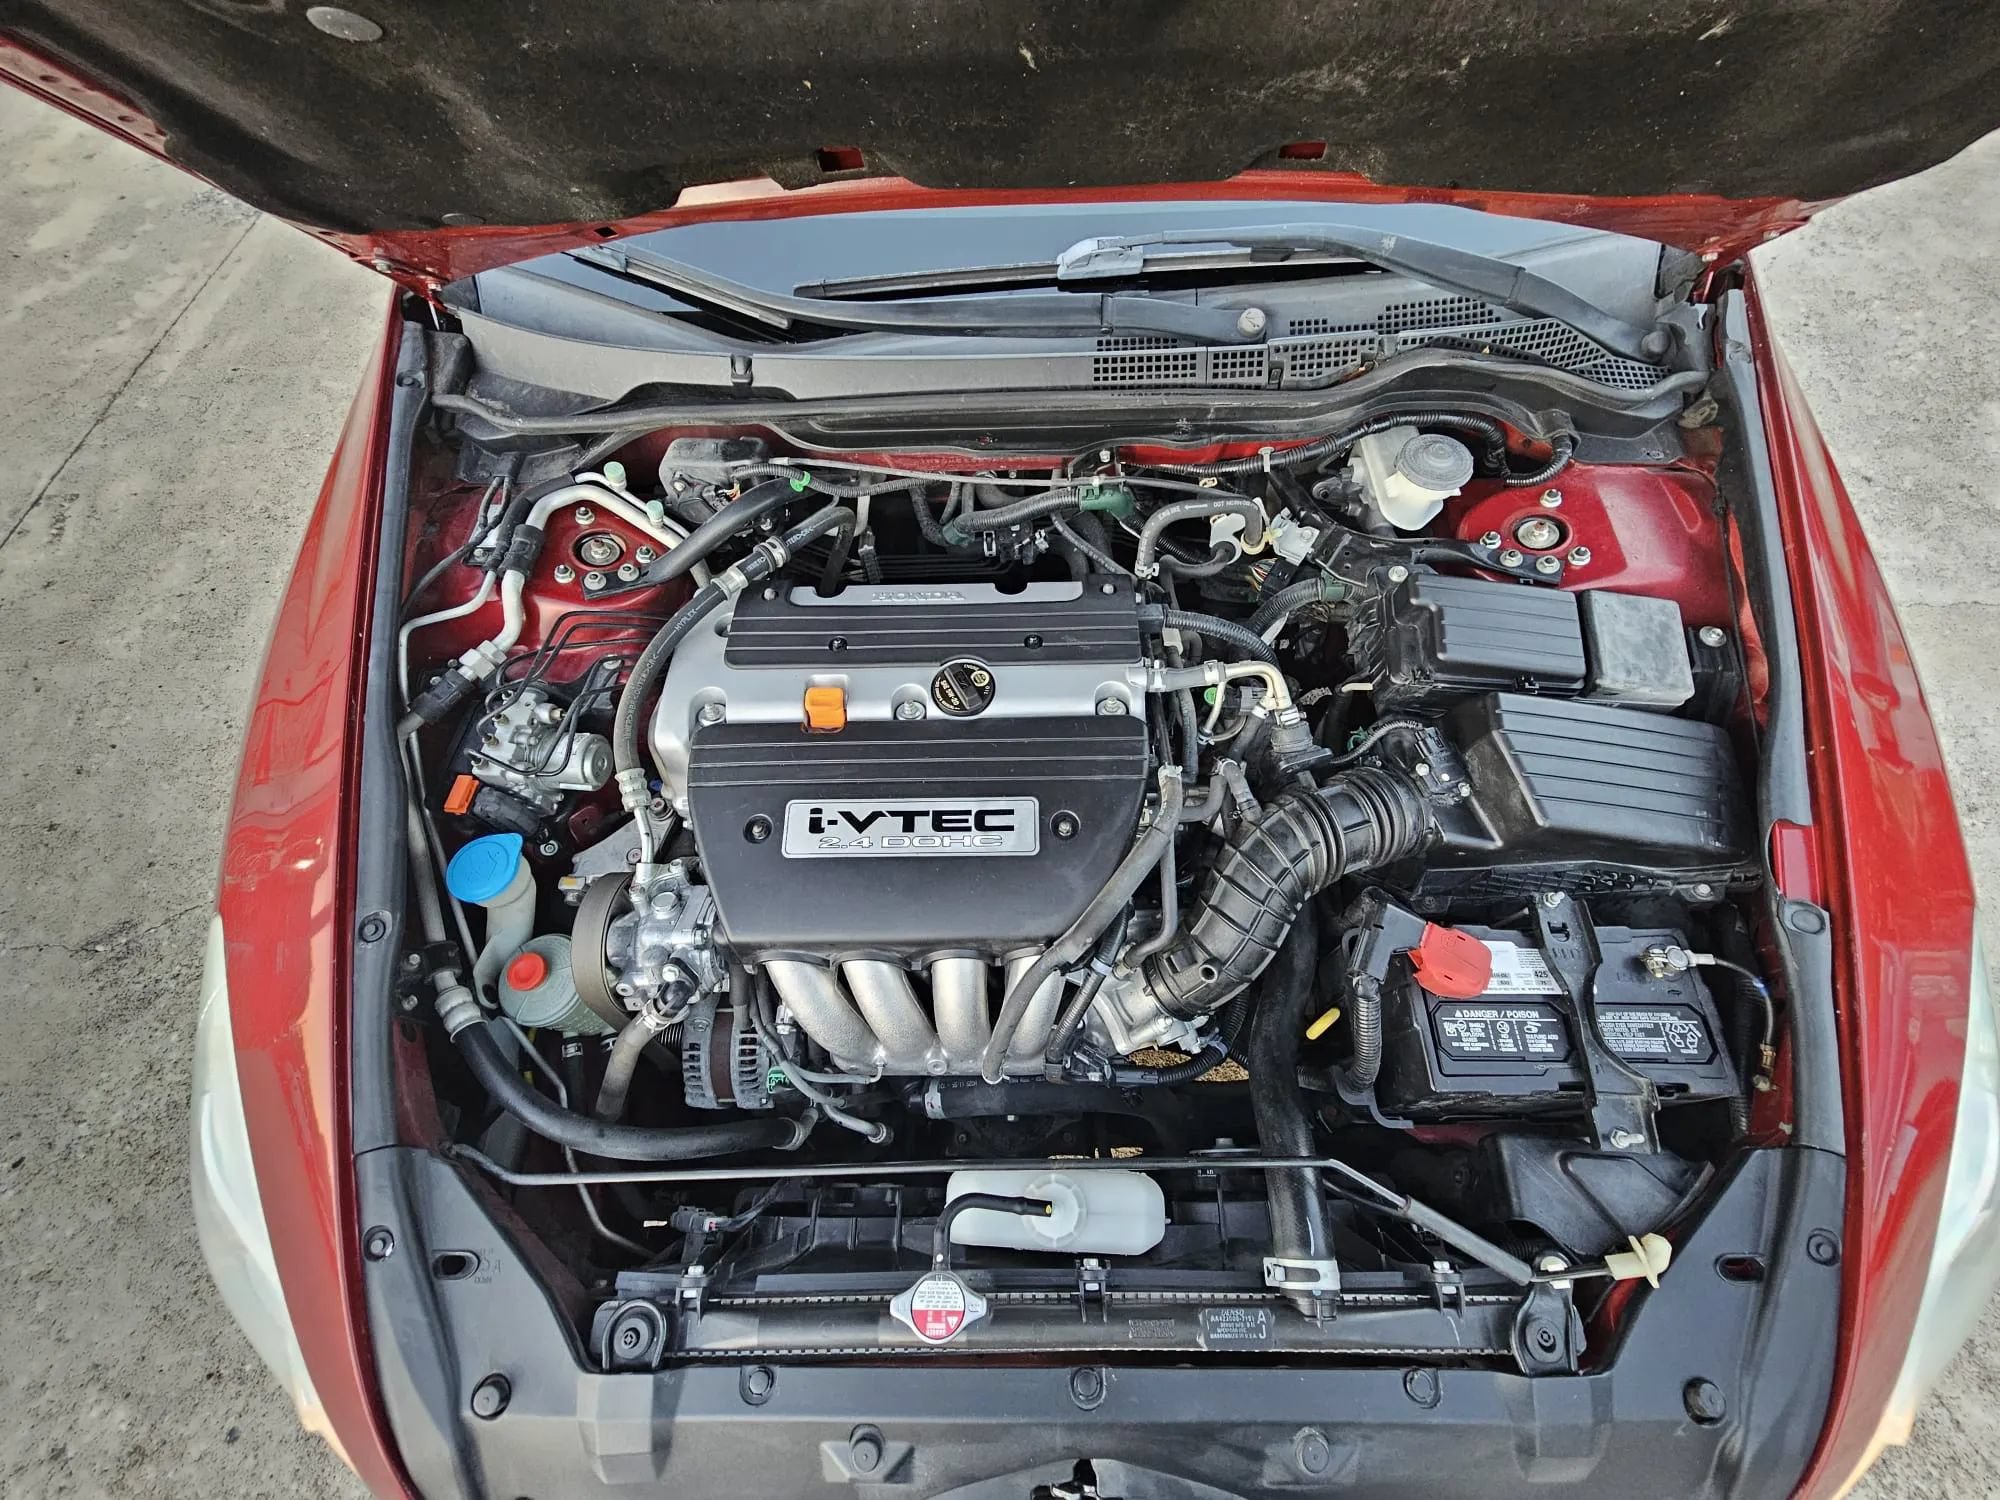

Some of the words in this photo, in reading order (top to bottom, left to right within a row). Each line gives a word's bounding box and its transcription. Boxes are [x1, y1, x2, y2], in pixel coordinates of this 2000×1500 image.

[872, 591, 966, 602] HONDA
[808, 807, 1015, 835] i-VTEC
[818, 836, 874, 849] 2.4
[880, 834, 1003, 849] DOHC
[1534, 970, 1549, 978] 425
[1463, 1009, 1499, 1018] DANGER
[1506, 1010, 1540, 1019] POISON
[1257, 1309, 1267, 1324] A
